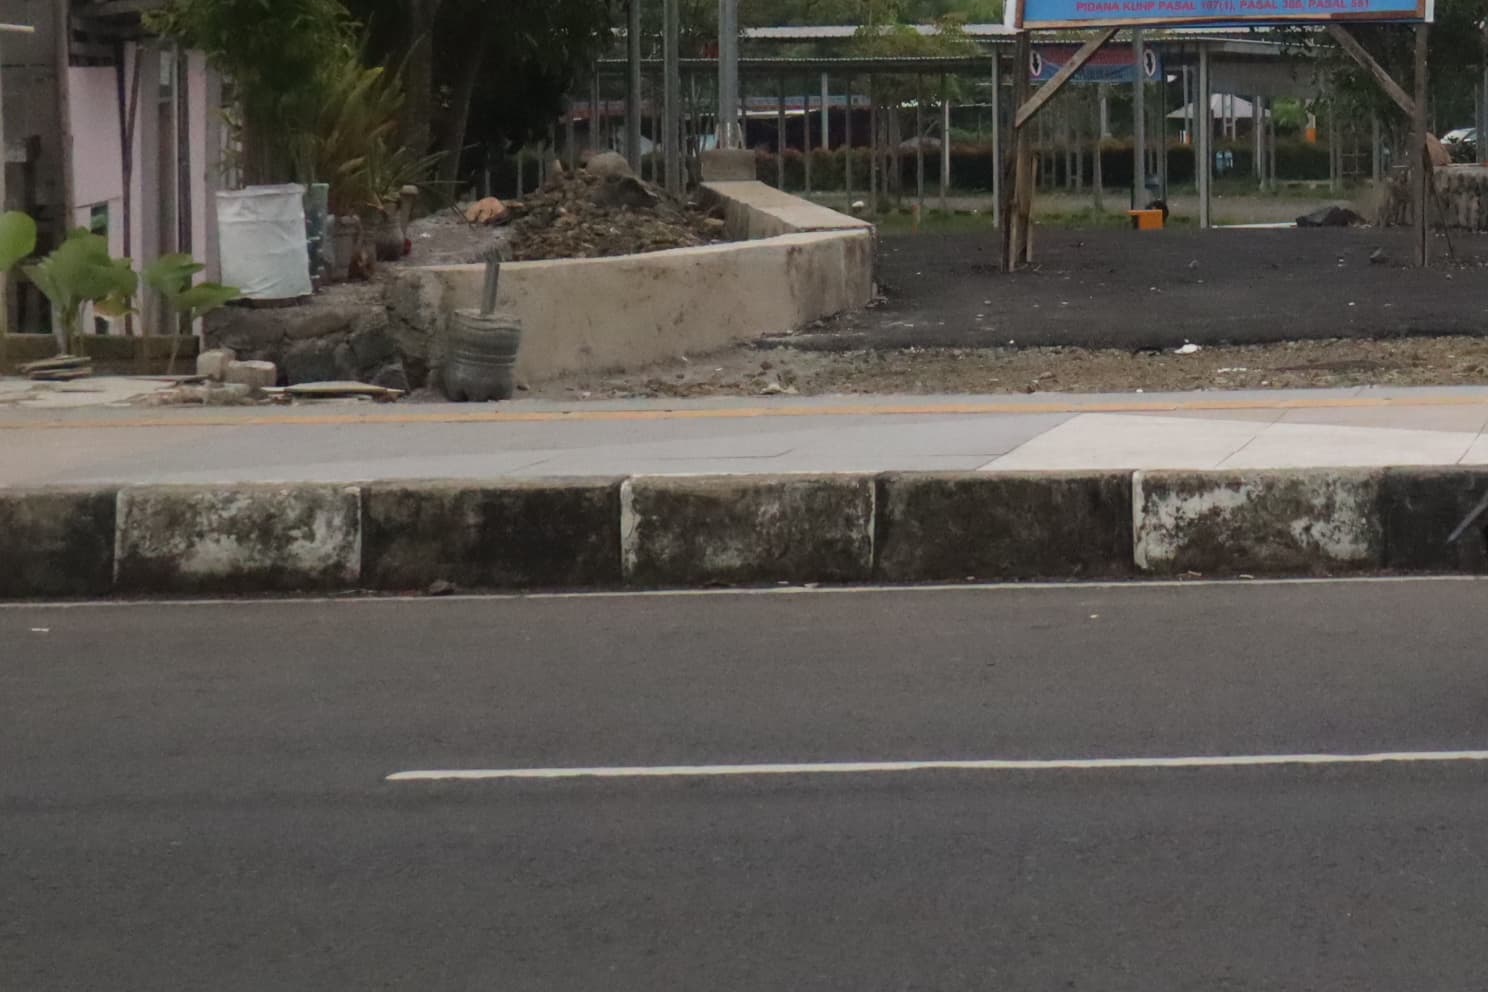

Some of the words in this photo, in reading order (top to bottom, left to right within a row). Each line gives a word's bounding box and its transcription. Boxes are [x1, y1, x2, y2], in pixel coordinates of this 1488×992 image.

[1076, 1, 1120, 12] PIDANA
[1123, 1, 1155, 11] KUHP
[1158, 0, 1196, 11] PASAL
[1239, 0, 1278, 10] PASAL
[1308, 0, 1347, 9] PASAL
